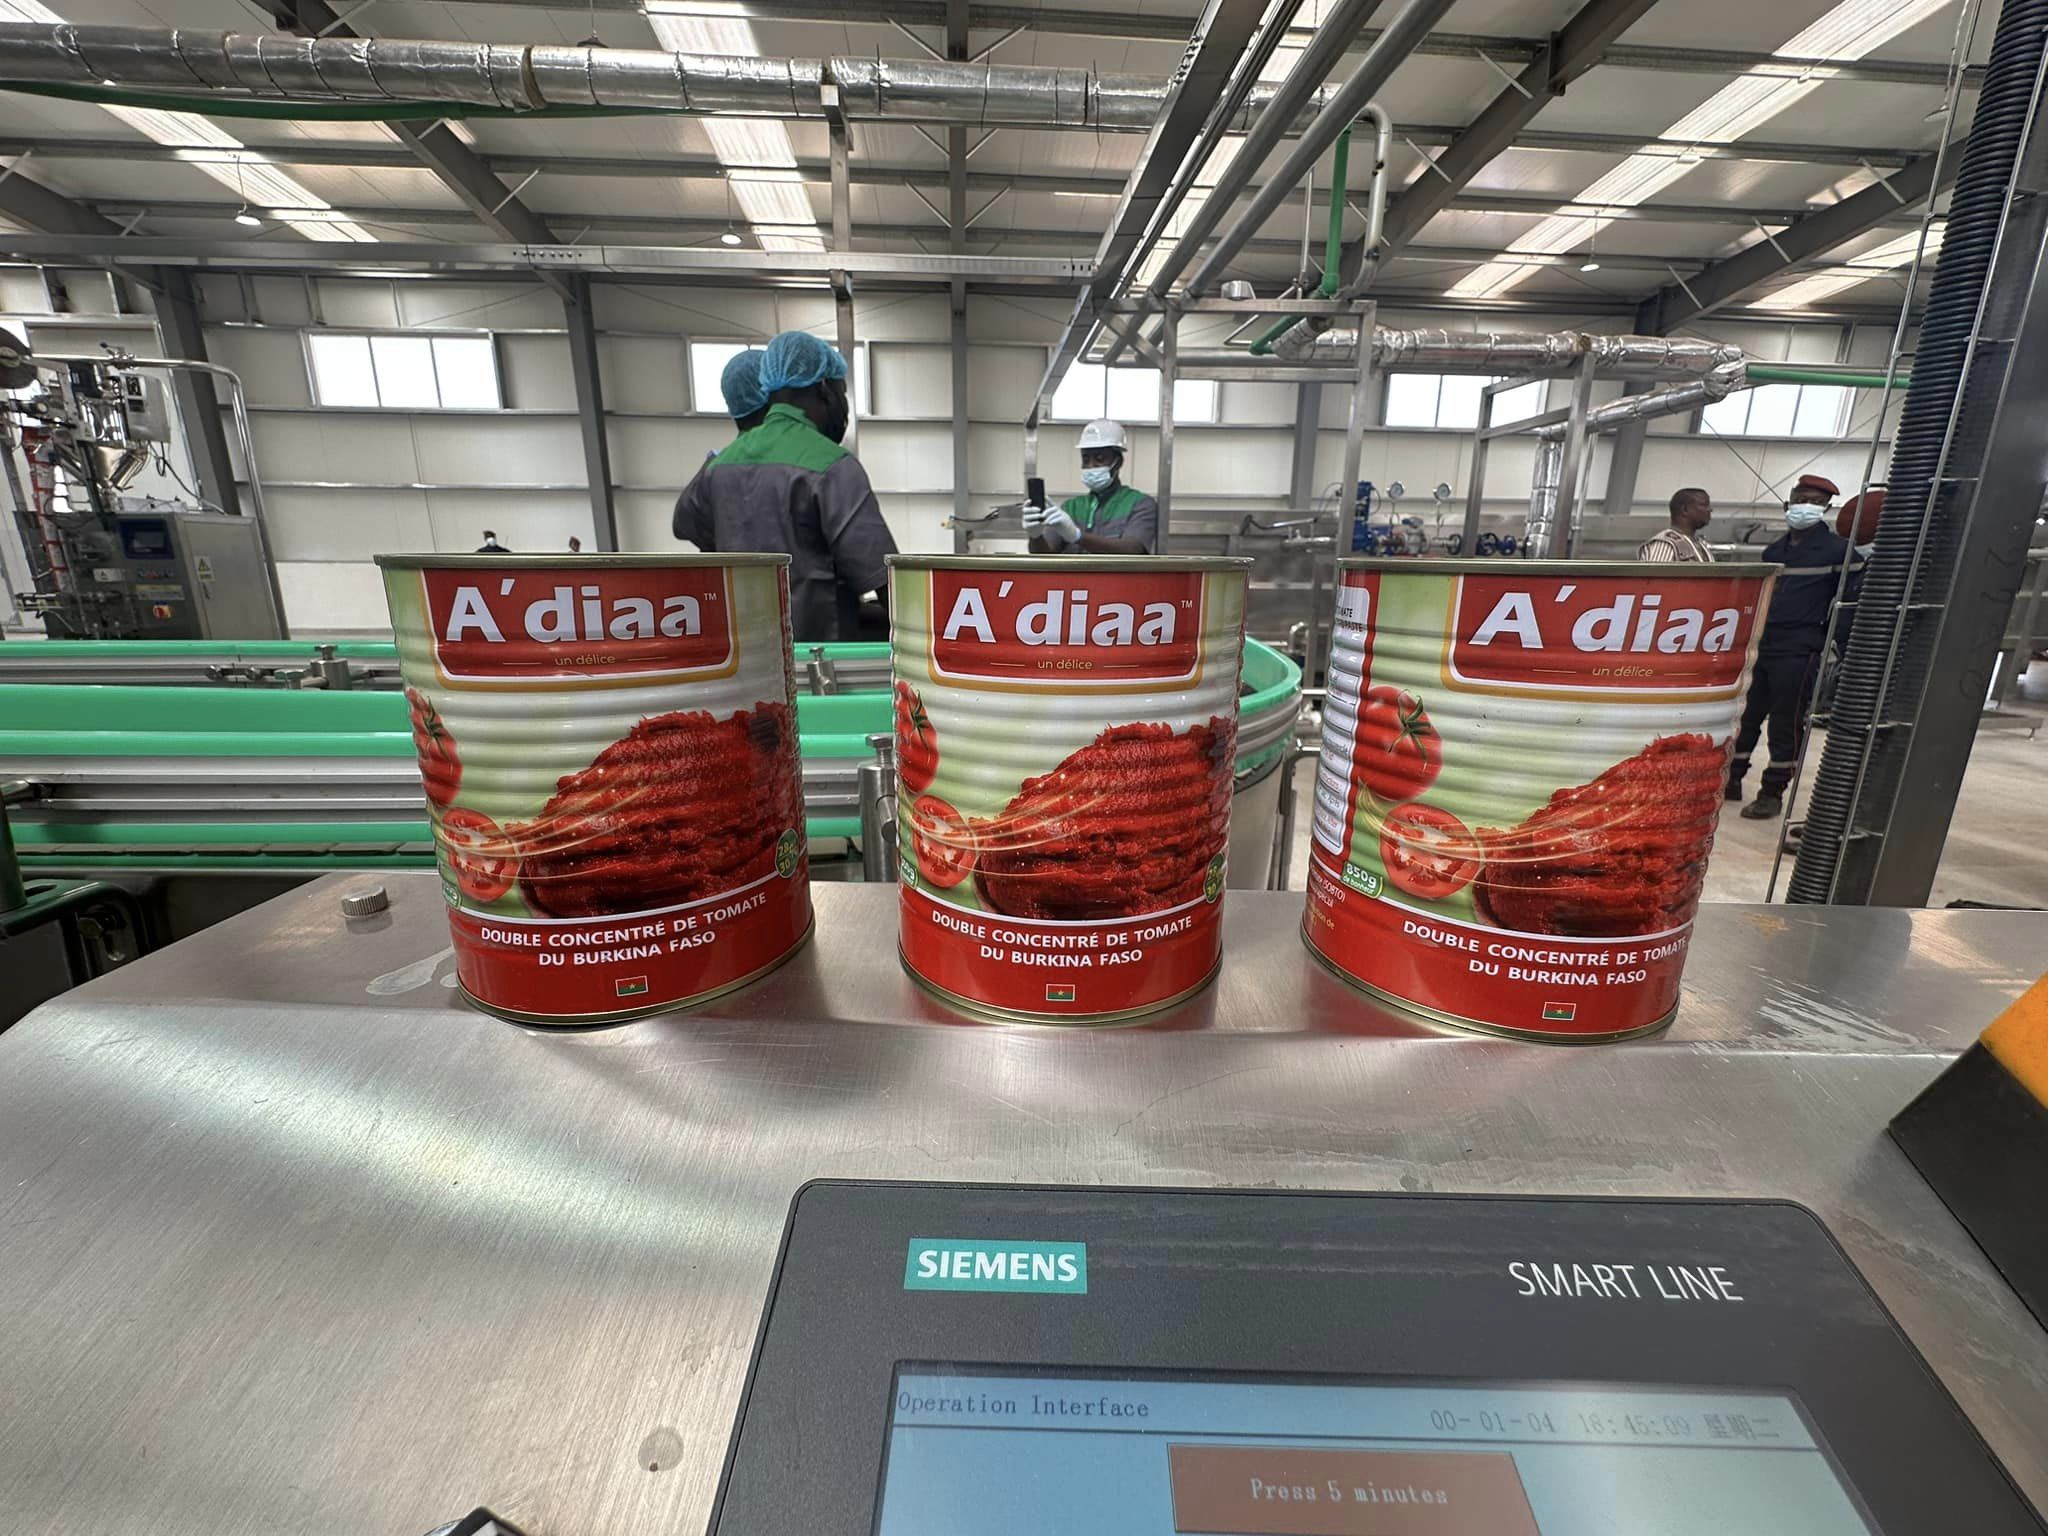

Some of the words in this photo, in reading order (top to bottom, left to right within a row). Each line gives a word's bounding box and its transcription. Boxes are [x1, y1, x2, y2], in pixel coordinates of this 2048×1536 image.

[555, 657, 572, 665] un
[575, 654, 616, 666] délice
[1037, 661, 1053, 669] un
[1056, 659, 1093, 670] délice
[1592, 667, 1609, 676] un
[1613, 665, 1654, 677] délice
[1346, 863, 1377, 889] 850g
[481, 927, 541, 947] DOUBLE
[549, 921, 666, 947] CONCENTRÉ
[673, 916, 697, 933] DE
[703, 893, 767, 925] TOMATE
[932, 911, 986, 938] DOUBLE
[992, 930, 1098, 948] CONCENTRÉ
[1106, 932, 1128, 946] DE
[1134, 915, 1192, 943] TOMATE
[539, 952, 564, 966] DU
[573, 944, 662, 965] BURKINA
[669, 930, 716, 952] FASO
[980, 945, 1004, 961] DU
[1011, 951, 1092, 967] BURKINA
[1100, 949, 1142, 965] FASO
[1403, 920, 1480, 952] DOUBLE
[1488, 944, 1609, 966] CONCENTRÉ
[1616, 952, 1637, 966] DE
[1644, 936, 1688, 961] TOMATE
[1468, 960, 1499, 975] DU
[1508, 967, 1598, 985] BURKINA
[1606, 969, 1646, 985] FASO
[917, 1250, 1077, 1282] SIEMENS
[1508, 1262, 1641, 1298] SMART
[1647, 1265, 1744, 1300] LINE
[899, 1392, 1016, 1414] Operation
[1031, 1395, 1149, 1418] Interface
[1702, 1414, 1780, 1440] 星期二
[1250, 1478, 1316, 1501] Press
[1328, 1480, 1341, 1501] 5
[1354, 1481, 1448, 1505] minutes
